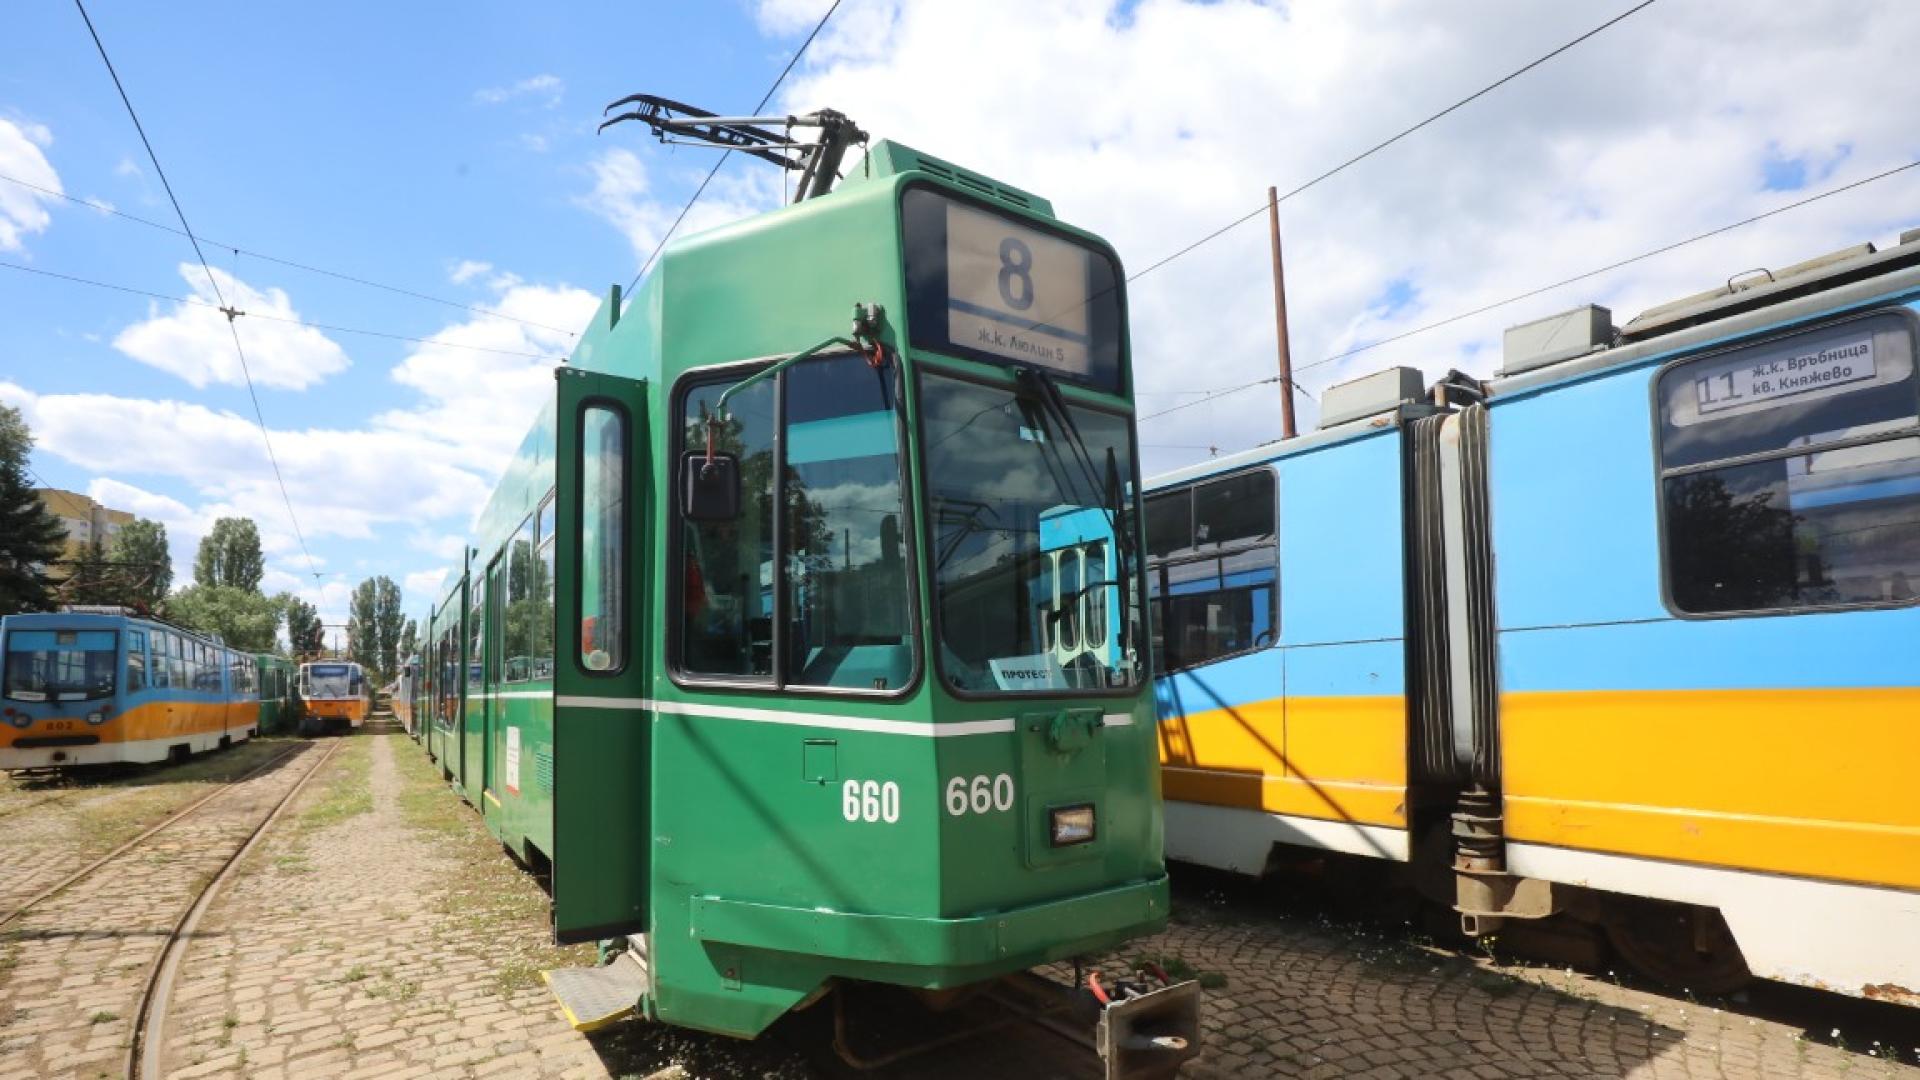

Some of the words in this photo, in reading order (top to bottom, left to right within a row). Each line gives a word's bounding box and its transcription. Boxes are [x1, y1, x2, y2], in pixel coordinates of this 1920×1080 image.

[997, 236, 1034, 311] 8
[977, 327, 1007, 348] ж.к.
[1009, 335, 1054, 360] Люлин
[1055, 347, 1064, 361] 5
[1752, 360, 1784, 378] ж.к.
[1787, 343, 1868, 371] Връбница
[1697, 371, 1743, 404] 11
[1752, 380, 1776, 396] кв.
[1779, 365, 1853, 390] Княжево
[842, 779, 900, 824] 660
[946, 773, 1015, 816] 660
